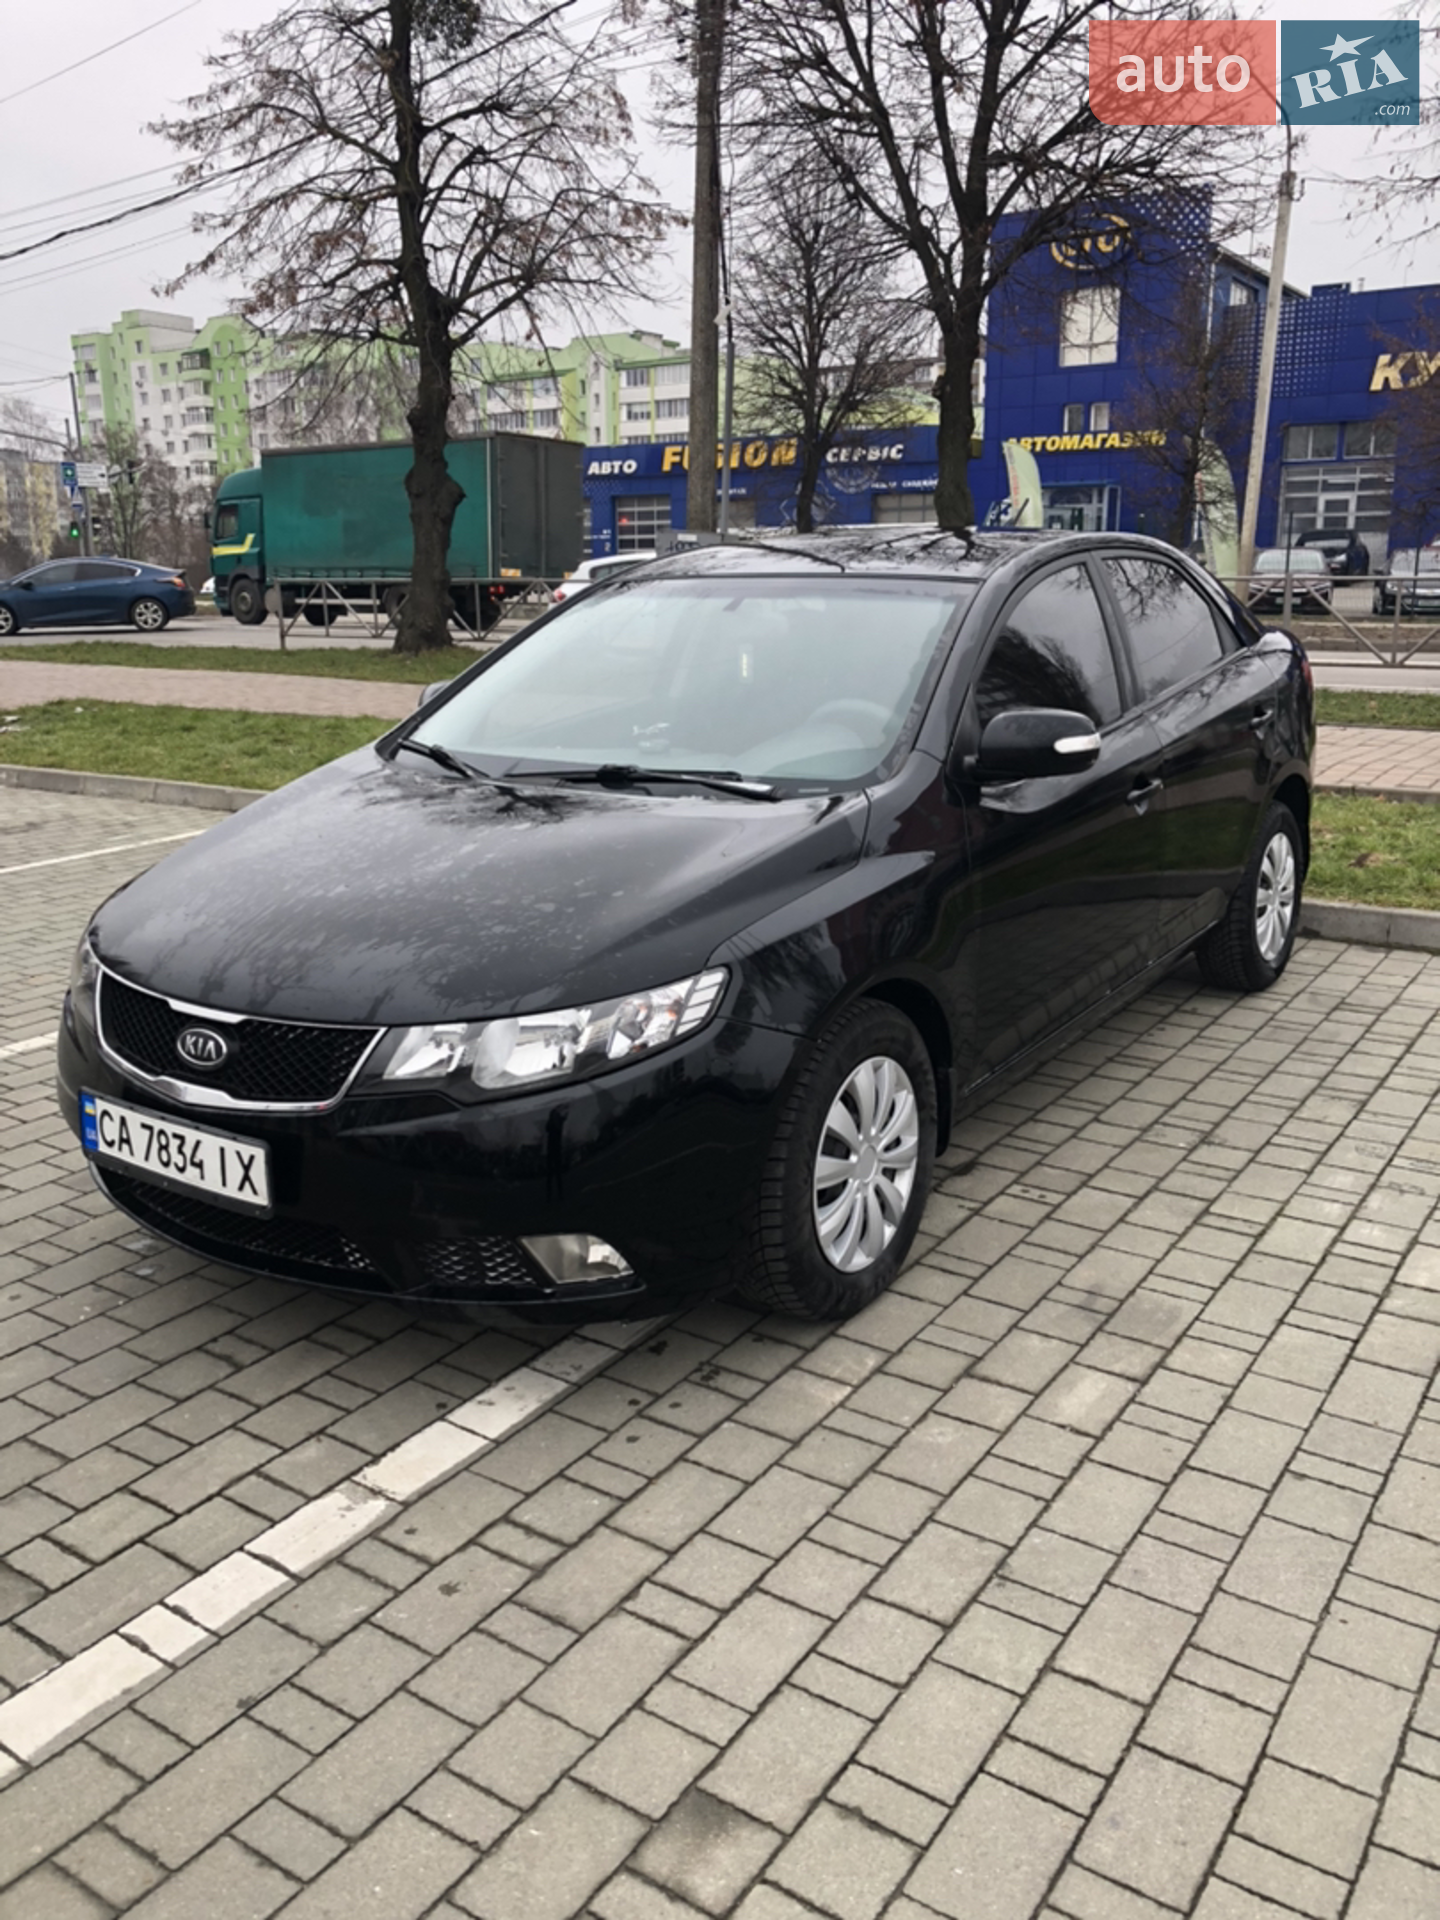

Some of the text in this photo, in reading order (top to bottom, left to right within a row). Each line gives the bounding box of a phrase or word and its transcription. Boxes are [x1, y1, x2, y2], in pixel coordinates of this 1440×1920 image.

[587, 459, 638, 475] АВТО
[662, 437, 798, 472] FION
[184, 1033, 217, 1060] KIA
[99, 1109, 259, 1196] CA 7834 IX
